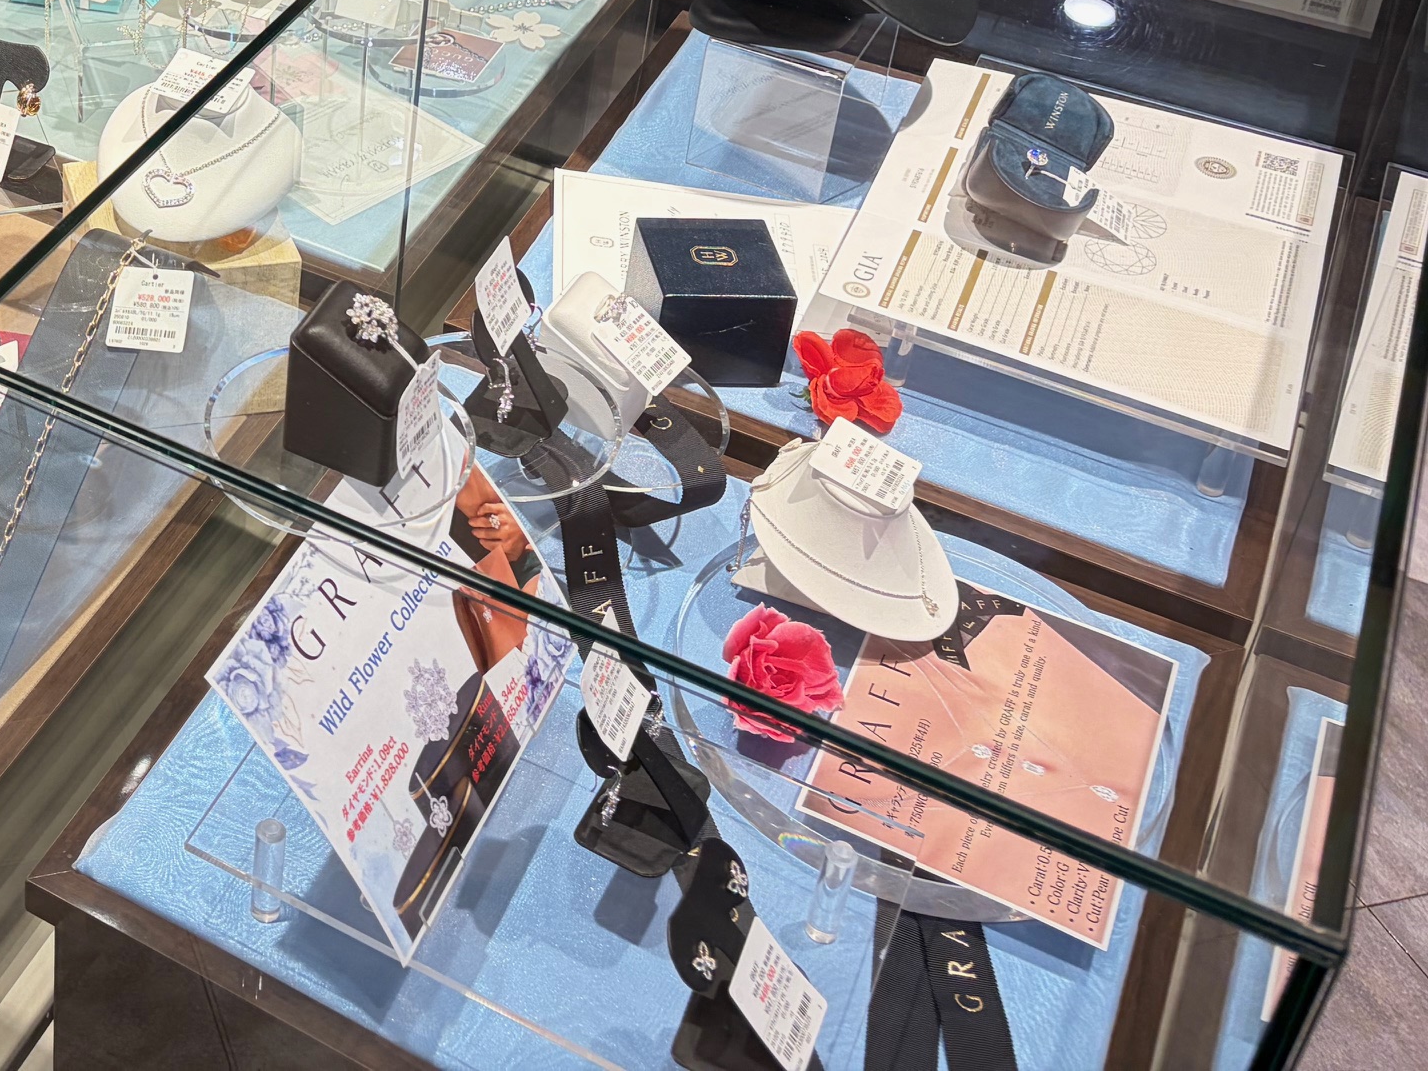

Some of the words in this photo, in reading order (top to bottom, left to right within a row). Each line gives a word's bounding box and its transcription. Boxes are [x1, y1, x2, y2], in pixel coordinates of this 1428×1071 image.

[1044, 91, 1070, 131] WINSTON
[618, 210, 630, 249] WINSTON
[854, 255, 883, 282] GIA
[1020, 654, 1030, 670] one
[318, 689, 355, 736] Wild
[347, 631, 394, 696] Flower
[1014, 666, 1027, 689] truly
[999, 697, 1018, 728] GRAFF
[1000, 756, 1015, 782] differs
[1026, 683, 1038, 702] and
[1032, 655, 1047, 685] quality.
[995, 726, 1009, 741] by
[344, 743, 375, 785] Earring
[985, 740, 1003, 770] created
[1113, 804, 1130, 825] Cut
[960, 827, 976, 850] piece
[951, 852, 969, 875] Each
